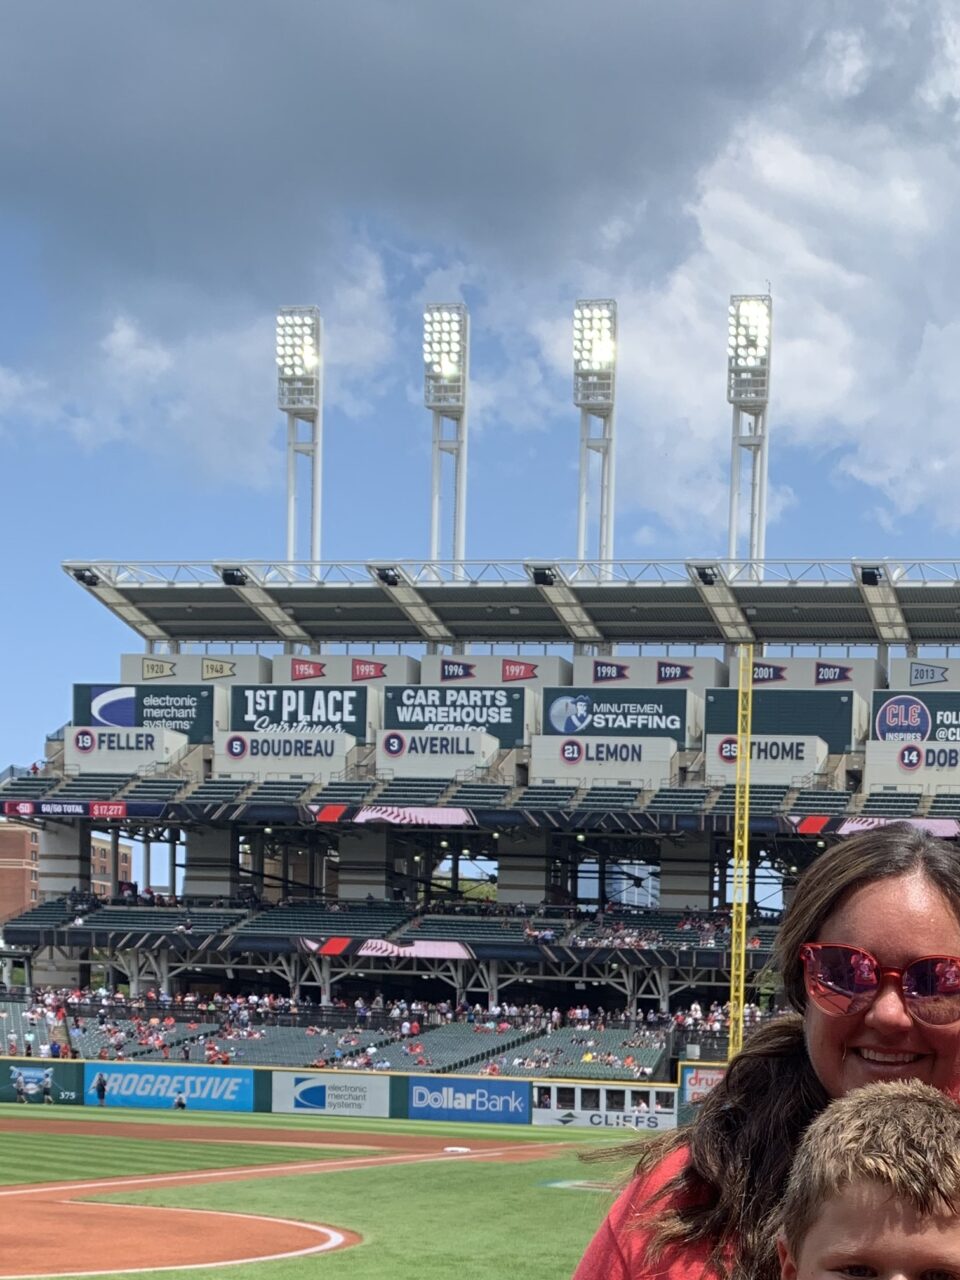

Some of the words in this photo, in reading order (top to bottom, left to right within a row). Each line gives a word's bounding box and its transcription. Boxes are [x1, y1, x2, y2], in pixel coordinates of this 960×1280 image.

[146, 663, 165, 675] 1920
[205, 663, 224, 675] 1948
[295, 664, 314, 676] 1954
[356, 664, 375, 676] 1995
[444, 664, 463, 677] 1996
[505, 664, 525, 677] 1997
[597, 665, 617, 678] 1998
[661, 666, 681, 679] 1999
[753, 667, 774, 679] 2001
[818, 668, 840, 679] 2007
[914, 667, 936, 680] 2013
[143, 694, 197, 706] electronic
[402, 689, 442, 707] CAR
[446, 689, 508, 707] PARTS
[143, 706, 196, 718] merchant
[244, 690, 277, 721] 1ST
[282, 690, 357, 722] PLACE
[593, 703, 663, 714] MINUTEMEN
[396, 707, 512, 723] WAREHOUSE
[886, 704, 921, 727] CLE
[143, 719, 191, 730] systems
[593, 715, 681, 729] STAFFING
[77, 735, 92, 748] 19
[98, 733, 155, 750] FELLER
[885, 732, 922, 741] INSPIRES
[232, 741, 241, 753] 5
[250, 739, 335, 757] BOUDREAU
[390, 738, 399, 751] 3
[407, 736, 475, 754] AVERILL
[722, 743, 738, 756] 25
[564, 746, 580, 758] 21
[585, 743, 642, 762] LEMON
[903, 751, 919, 764] 14
[63, 803, 84, 813] TOTAL
[328, 1084, 367, 1092] electronic
[59, 1091, 76, 1100] 375
[328, 1093, 366, 1101] merchant
[412, 1086, 523, 1112] DollarBank
[328, 1101, 363, 1110] systems
[590, 1114, 658, 1129] CLIFFS
